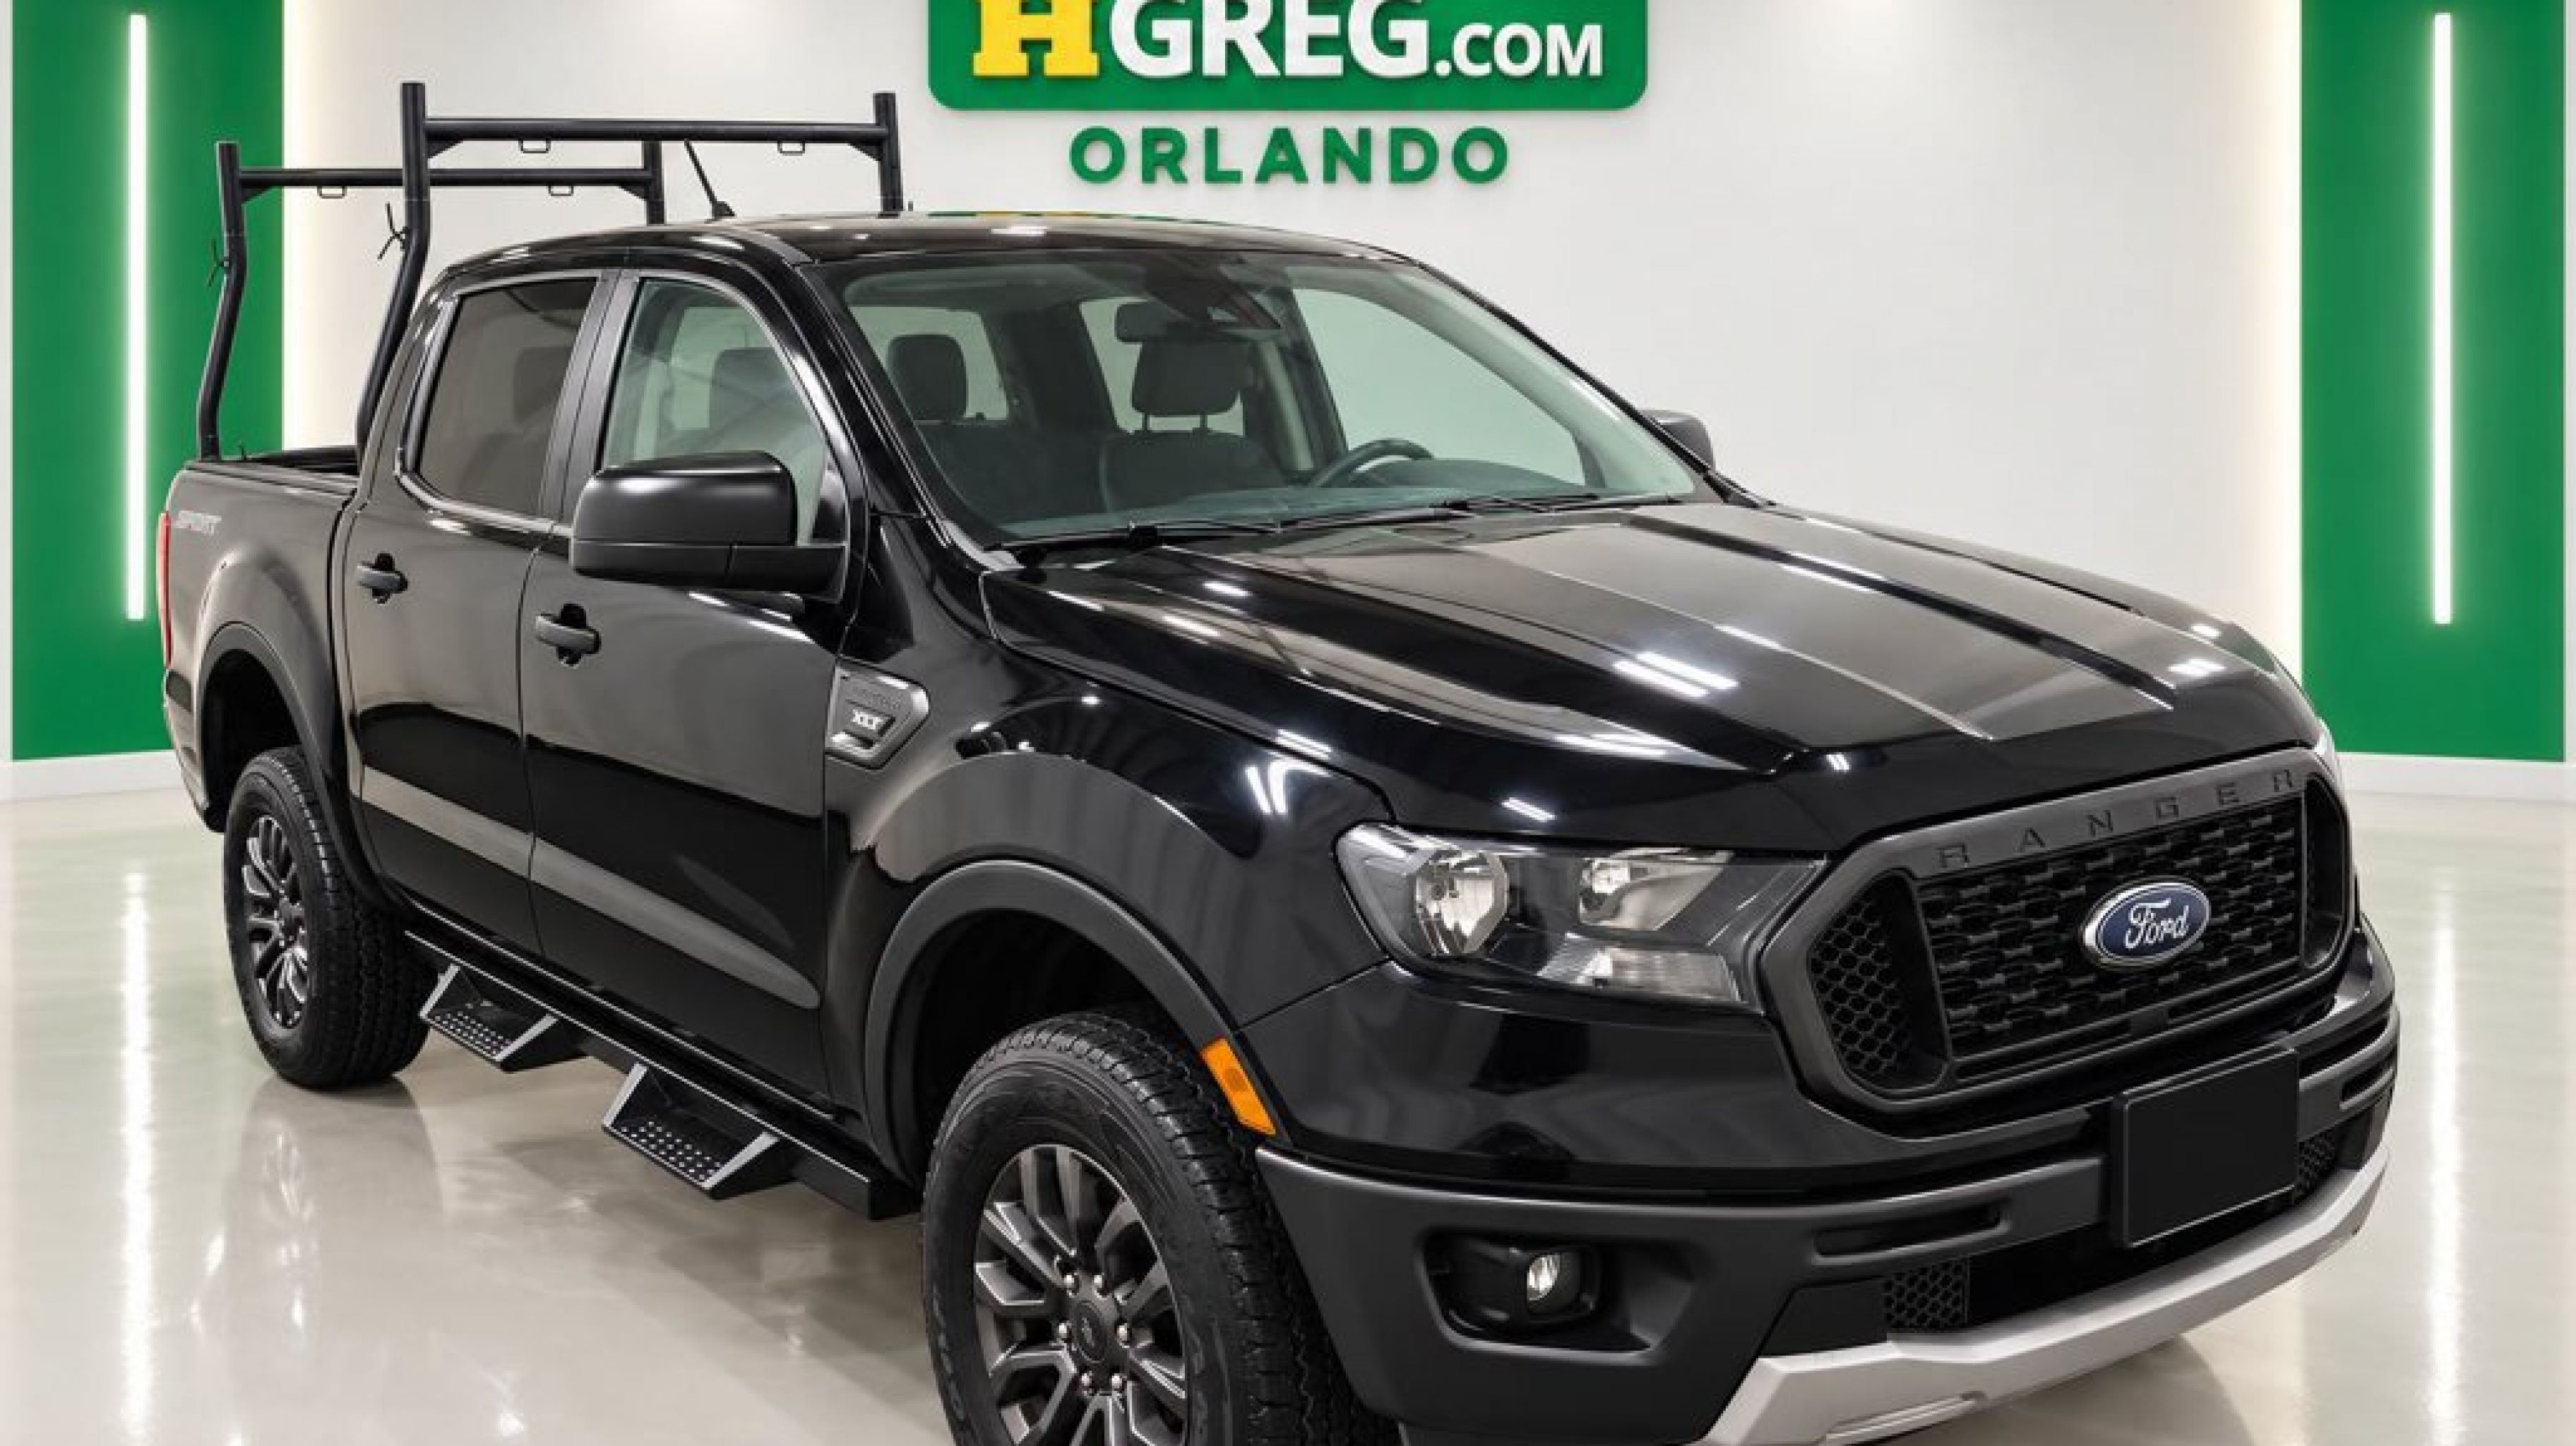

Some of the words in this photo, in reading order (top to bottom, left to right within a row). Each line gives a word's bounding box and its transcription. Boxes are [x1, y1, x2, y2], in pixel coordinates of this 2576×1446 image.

[1070, 126, 1509, 184] ORLANDO
[1938, 768, 2295, 868] RANGER
[2124, 897, 2190, 949] Ford
